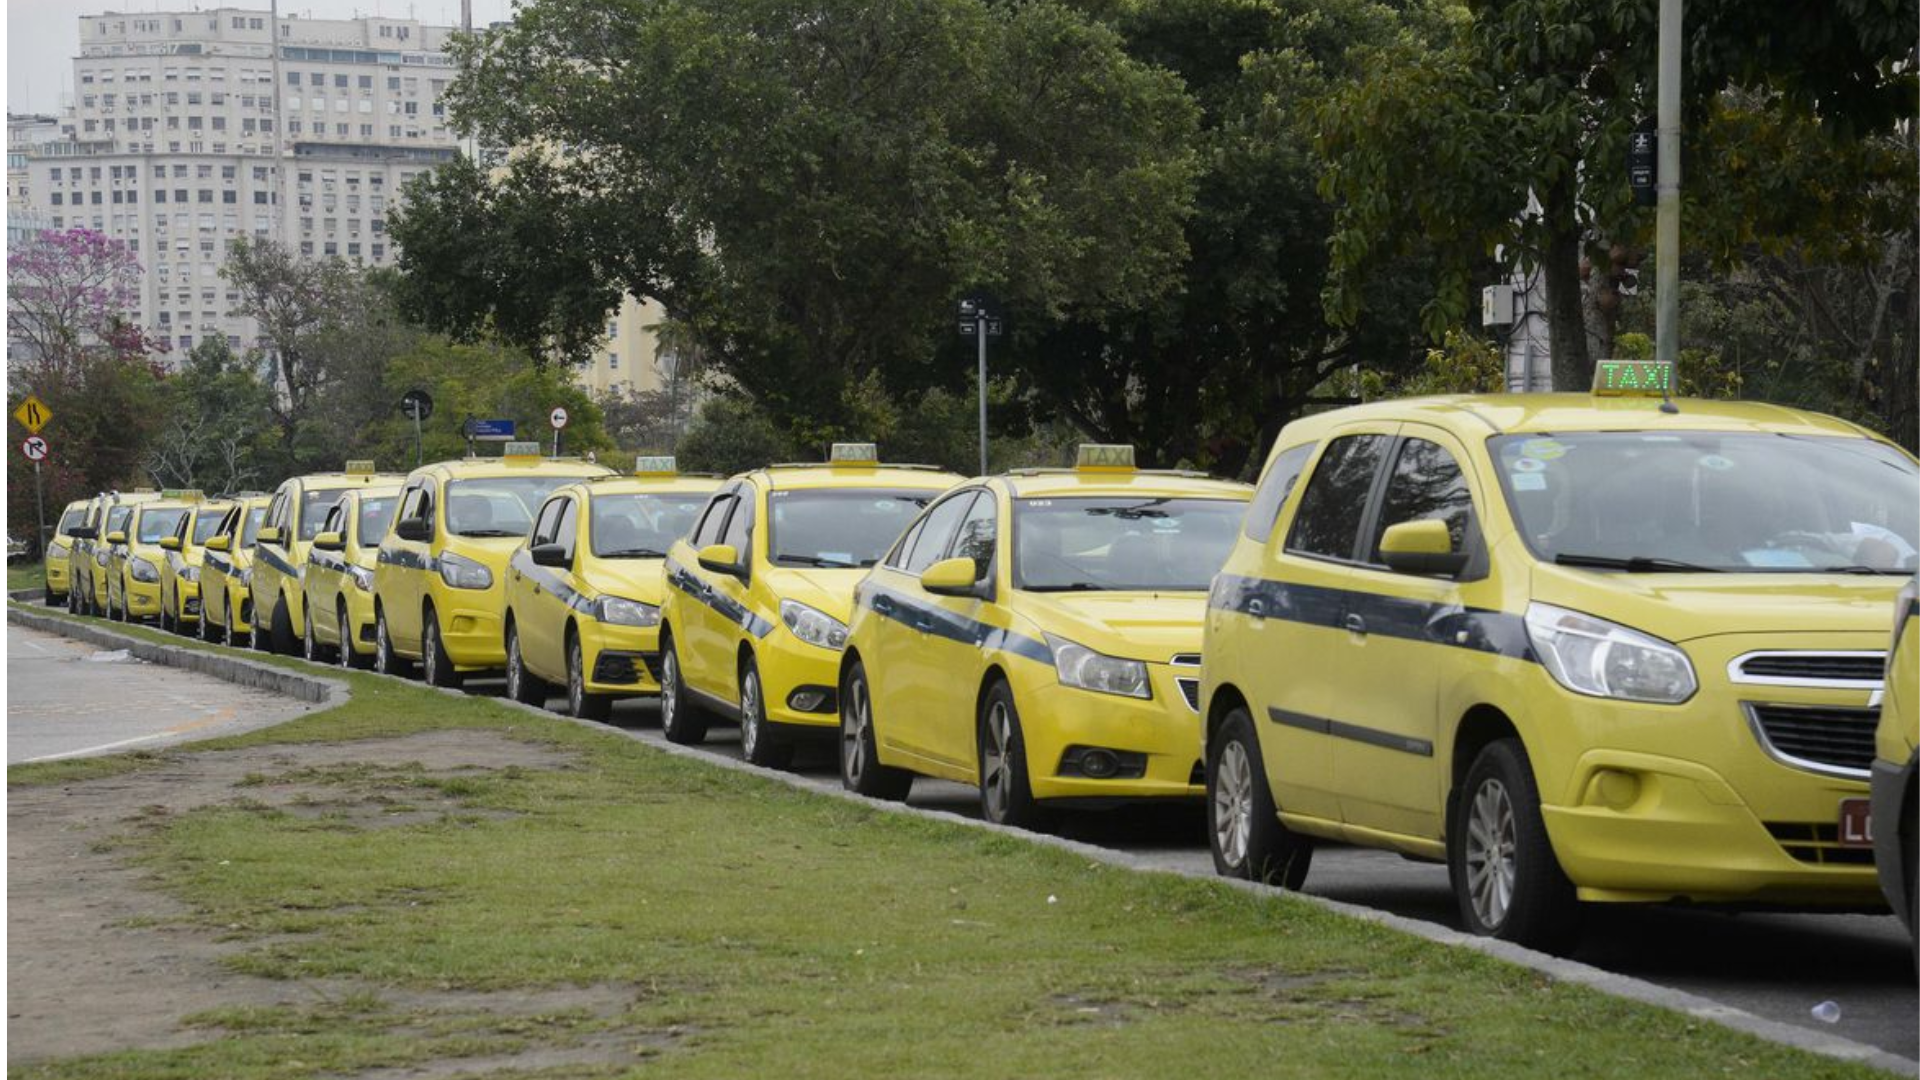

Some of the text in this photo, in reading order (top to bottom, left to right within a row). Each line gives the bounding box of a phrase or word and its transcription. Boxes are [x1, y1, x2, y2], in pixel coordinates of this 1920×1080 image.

[1602, 363, 1669, 390] TAXI
[639, 458, 673, 471] TAXI
[1085, 446, 1131, 466] TAXI
